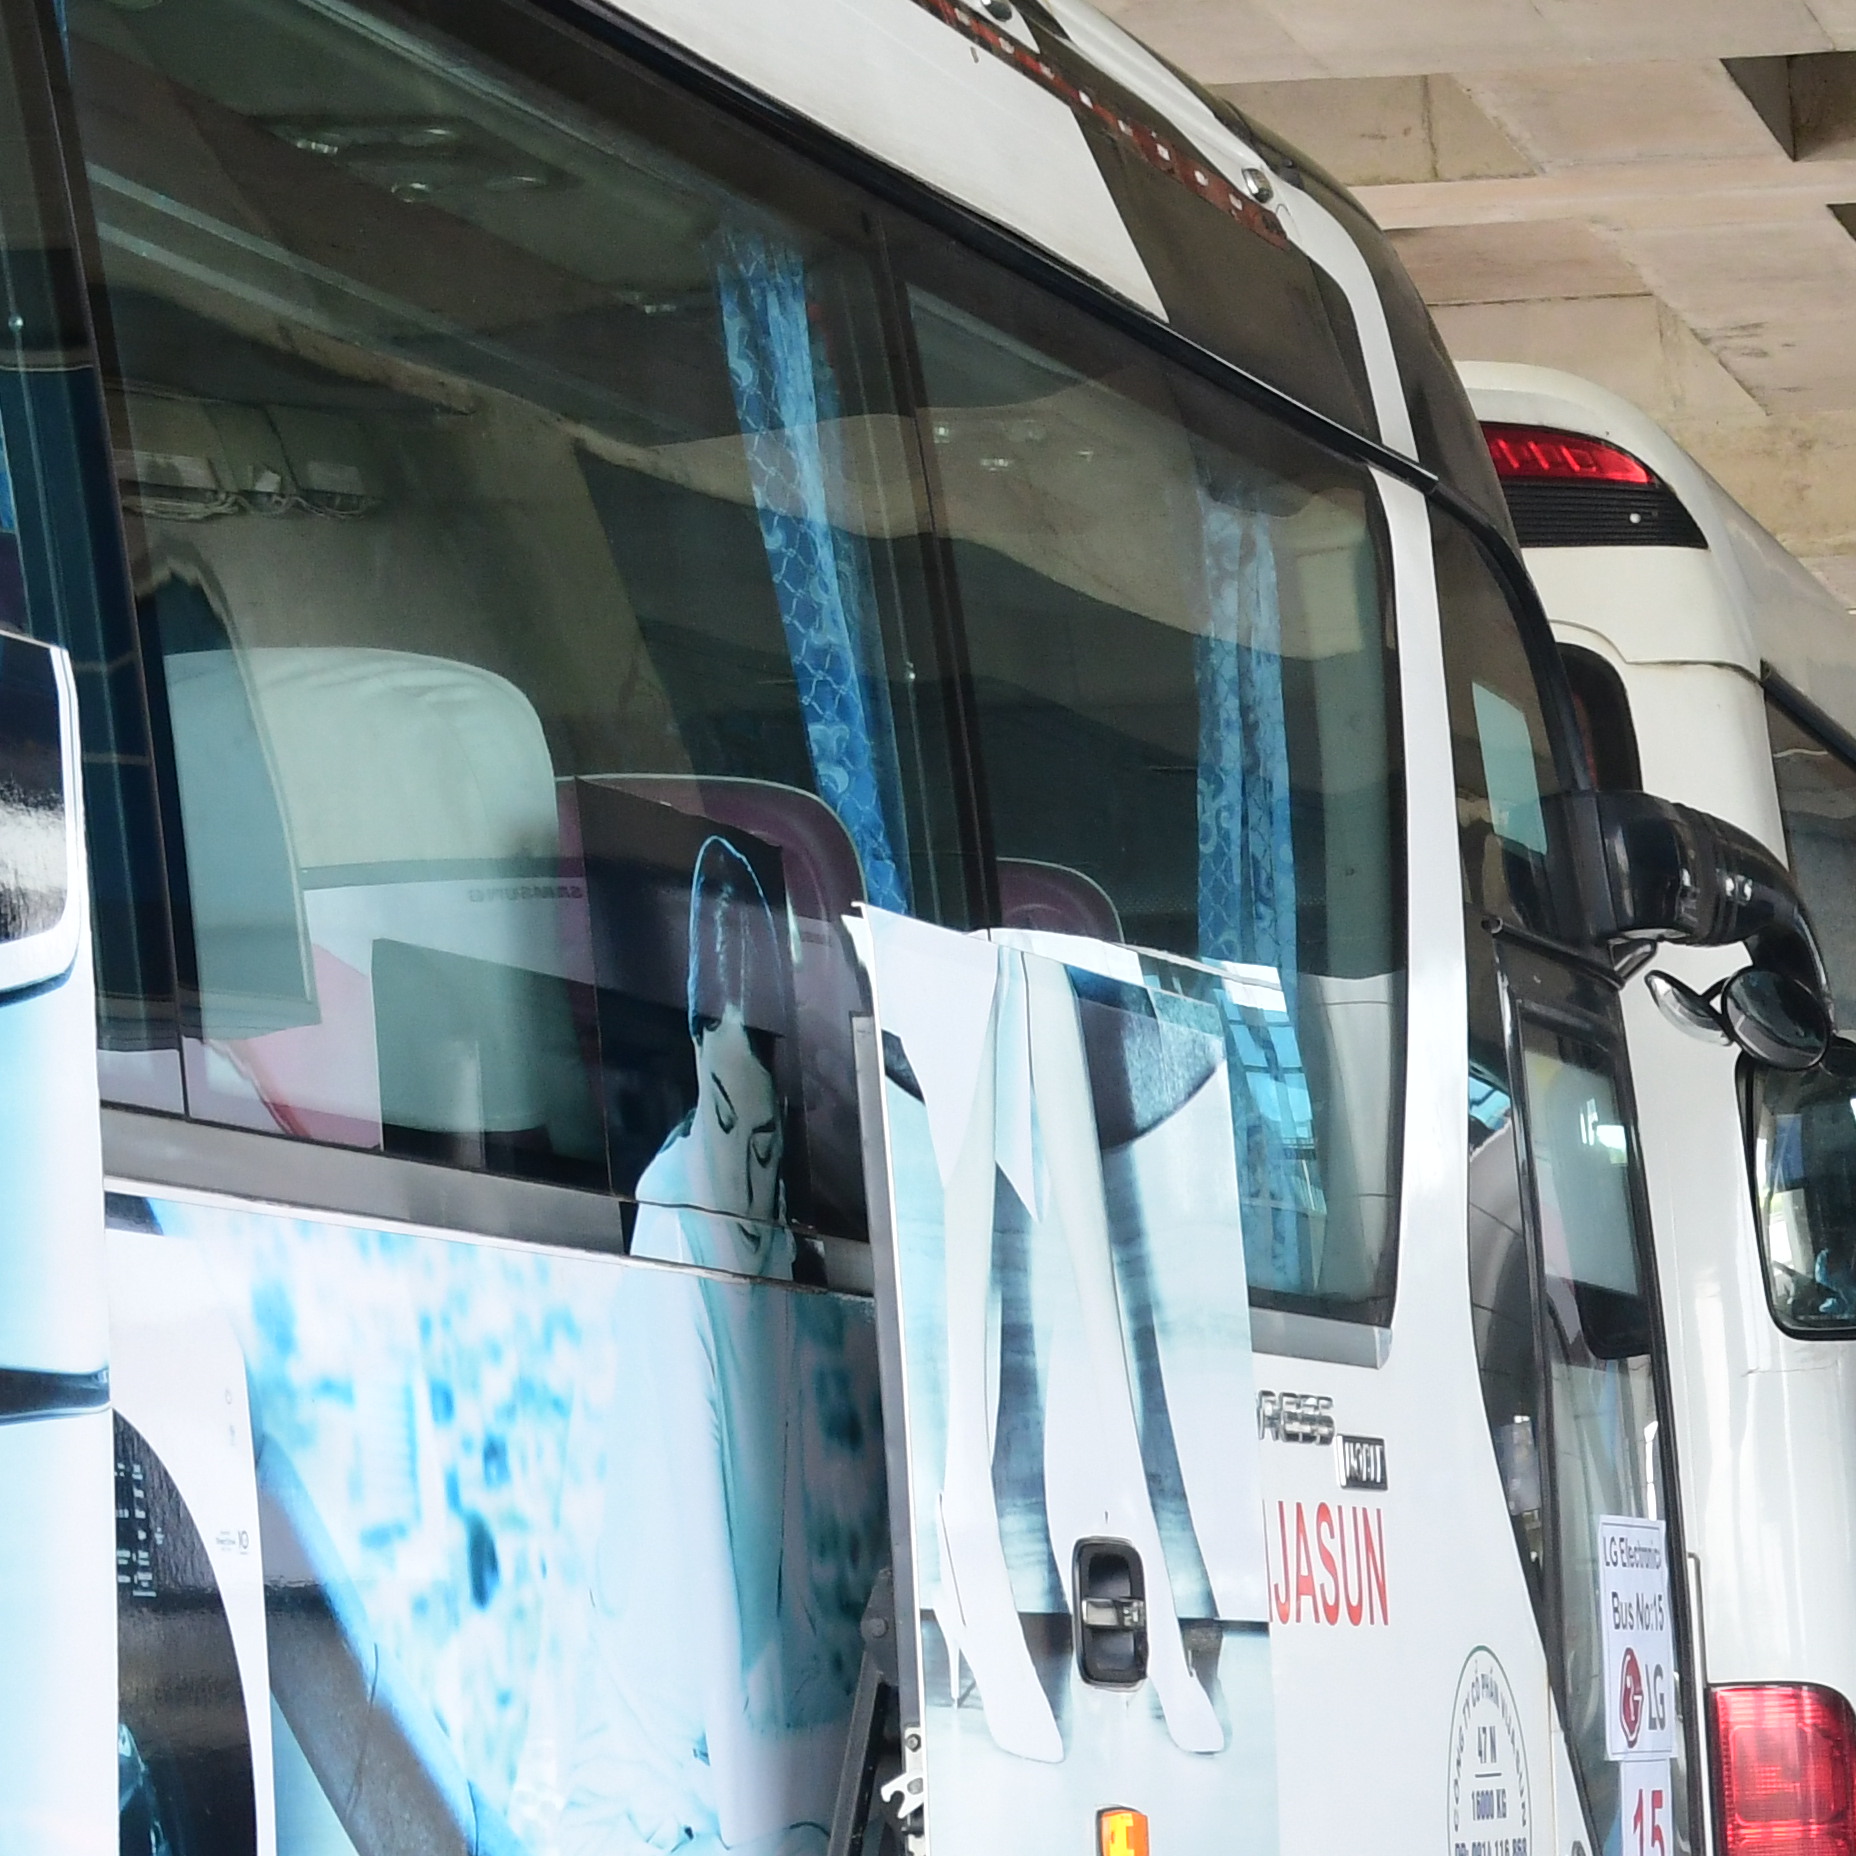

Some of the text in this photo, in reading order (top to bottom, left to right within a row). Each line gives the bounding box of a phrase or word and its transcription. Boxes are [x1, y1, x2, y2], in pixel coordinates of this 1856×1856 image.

[1603, 1536, 1618, 1567] LG
[1611, 1591, 1665, 1632] Bus No:15
[1645, 1663, 1665, 1732] LG
